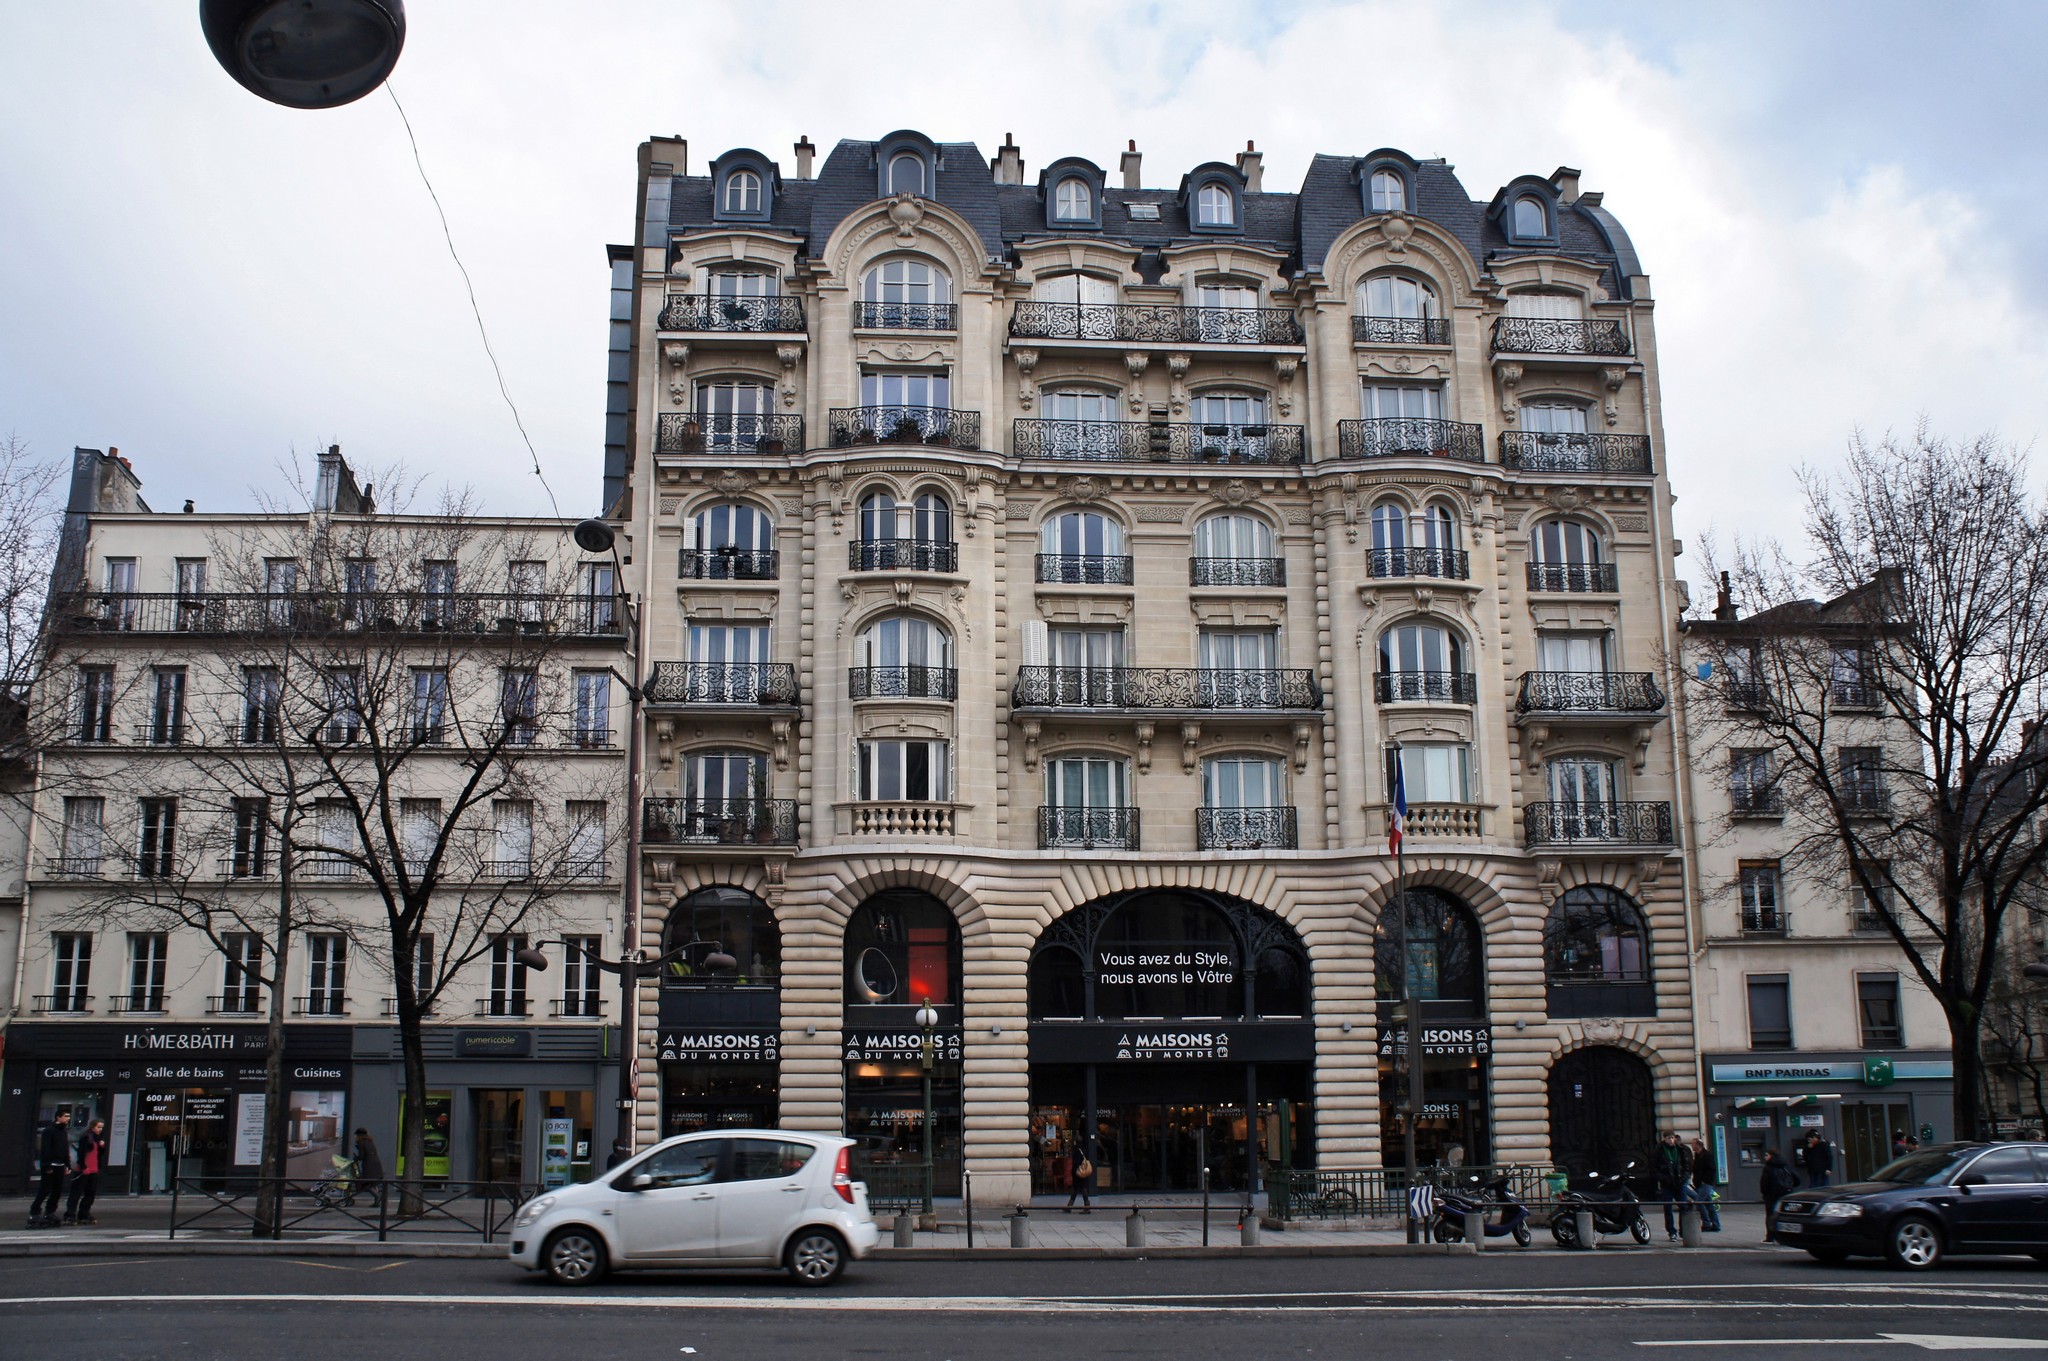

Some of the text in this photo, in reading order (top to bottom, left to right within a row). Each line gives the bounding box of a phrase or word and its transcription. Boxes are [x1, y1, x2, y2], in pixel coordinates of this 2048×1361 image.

[1100, 952, 1232, 967] Vous avez du Style,
[1101, 971, 1233, 984] nous avons le Vôtre
[681, 1034, 760, 1048] MAISONS
[1135, 1033, 1213, 1047] MAISONS
[1421, 1029, 1473, 1043] ISONS
[1135, 1050, 1213, 1059] DU MONDE
[1425, 1046, 1473, 1054] MONDE
[680, 1052, 760, 1060] DU MONDE
[865, 1052, 944, 1060] DU MONE
[44, 1067, 105, 1080] Carrelages
[145, 1067, 224, 1078] Salle de bains
[294, 1067, 342, 1078] Cuisines
[1745, 1068, 1830, 1078] BNP PARIBAS
[146, 1094, 162, 1102] 600
[1423, 1104, 1450, 1112] SONS
[138, 1113, 180, 1121] 3 niveaux
